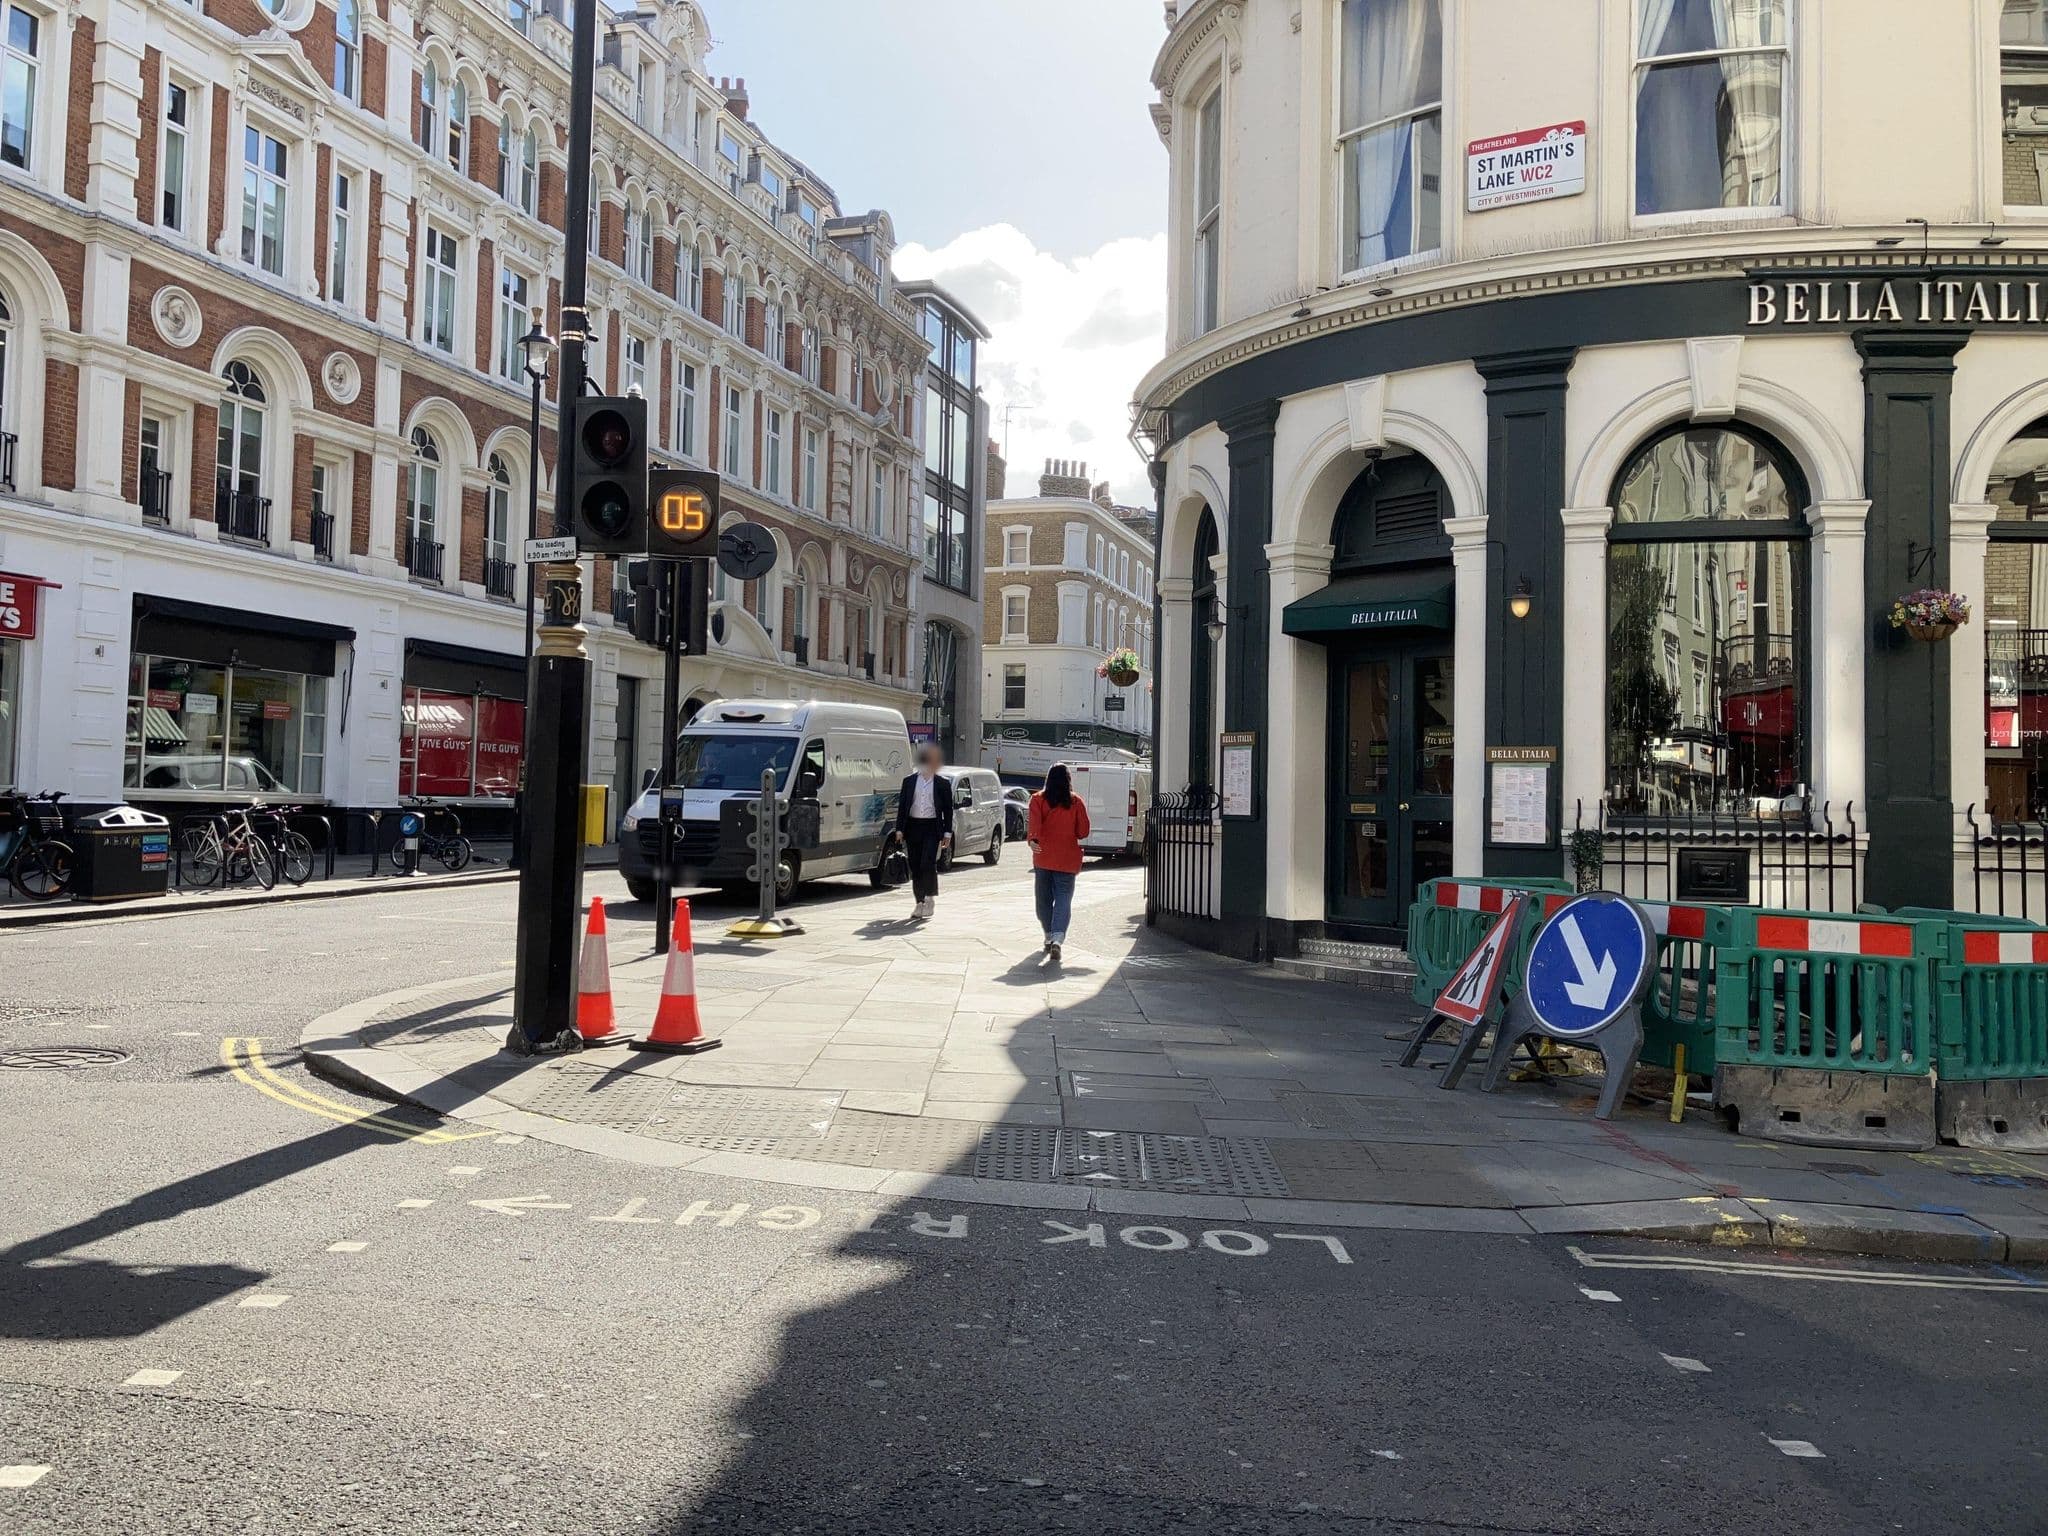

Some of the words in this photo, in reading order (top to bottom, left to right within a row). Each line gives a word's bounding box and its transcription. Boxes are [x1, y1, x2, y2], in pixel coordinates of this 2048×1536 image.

[1471, 136, 1517, 152] THEATRELAND
[1477, 157, 1495, 173] ST
[1501, 142, 1574, 169] MARTIN'S
[1478, 171, 1515, 191] LANE
[1521, 164, 1553, 183] WC2
[1477, 197, 1492, 206] CITY
[1494, 196, 1503, 204] OF
[1505, 186, 1554, 201] WESTMINSTER
[1747, 281, 1903, 325] BELLA
[1917, 281, 2048, 323] ITALI
[664, 495, 703, 530] 05
[1351, 612, 1381, 624] BELLA
[1384, 608, 1418, 621] ITALIA
[548, 658, 554, 670] 1
[421, 739, 441, 749] FIVE
[443, 740, 466, 750] GUYS
[480, 742, 497, 752] FIVE
[498, 743, 520, 754] GUYS
[1491, 750, 1518, 758] BELLA
[1521, 750, 1550, 758] ITALIA
[1041, 1220, 1354, 1264] LOOK
